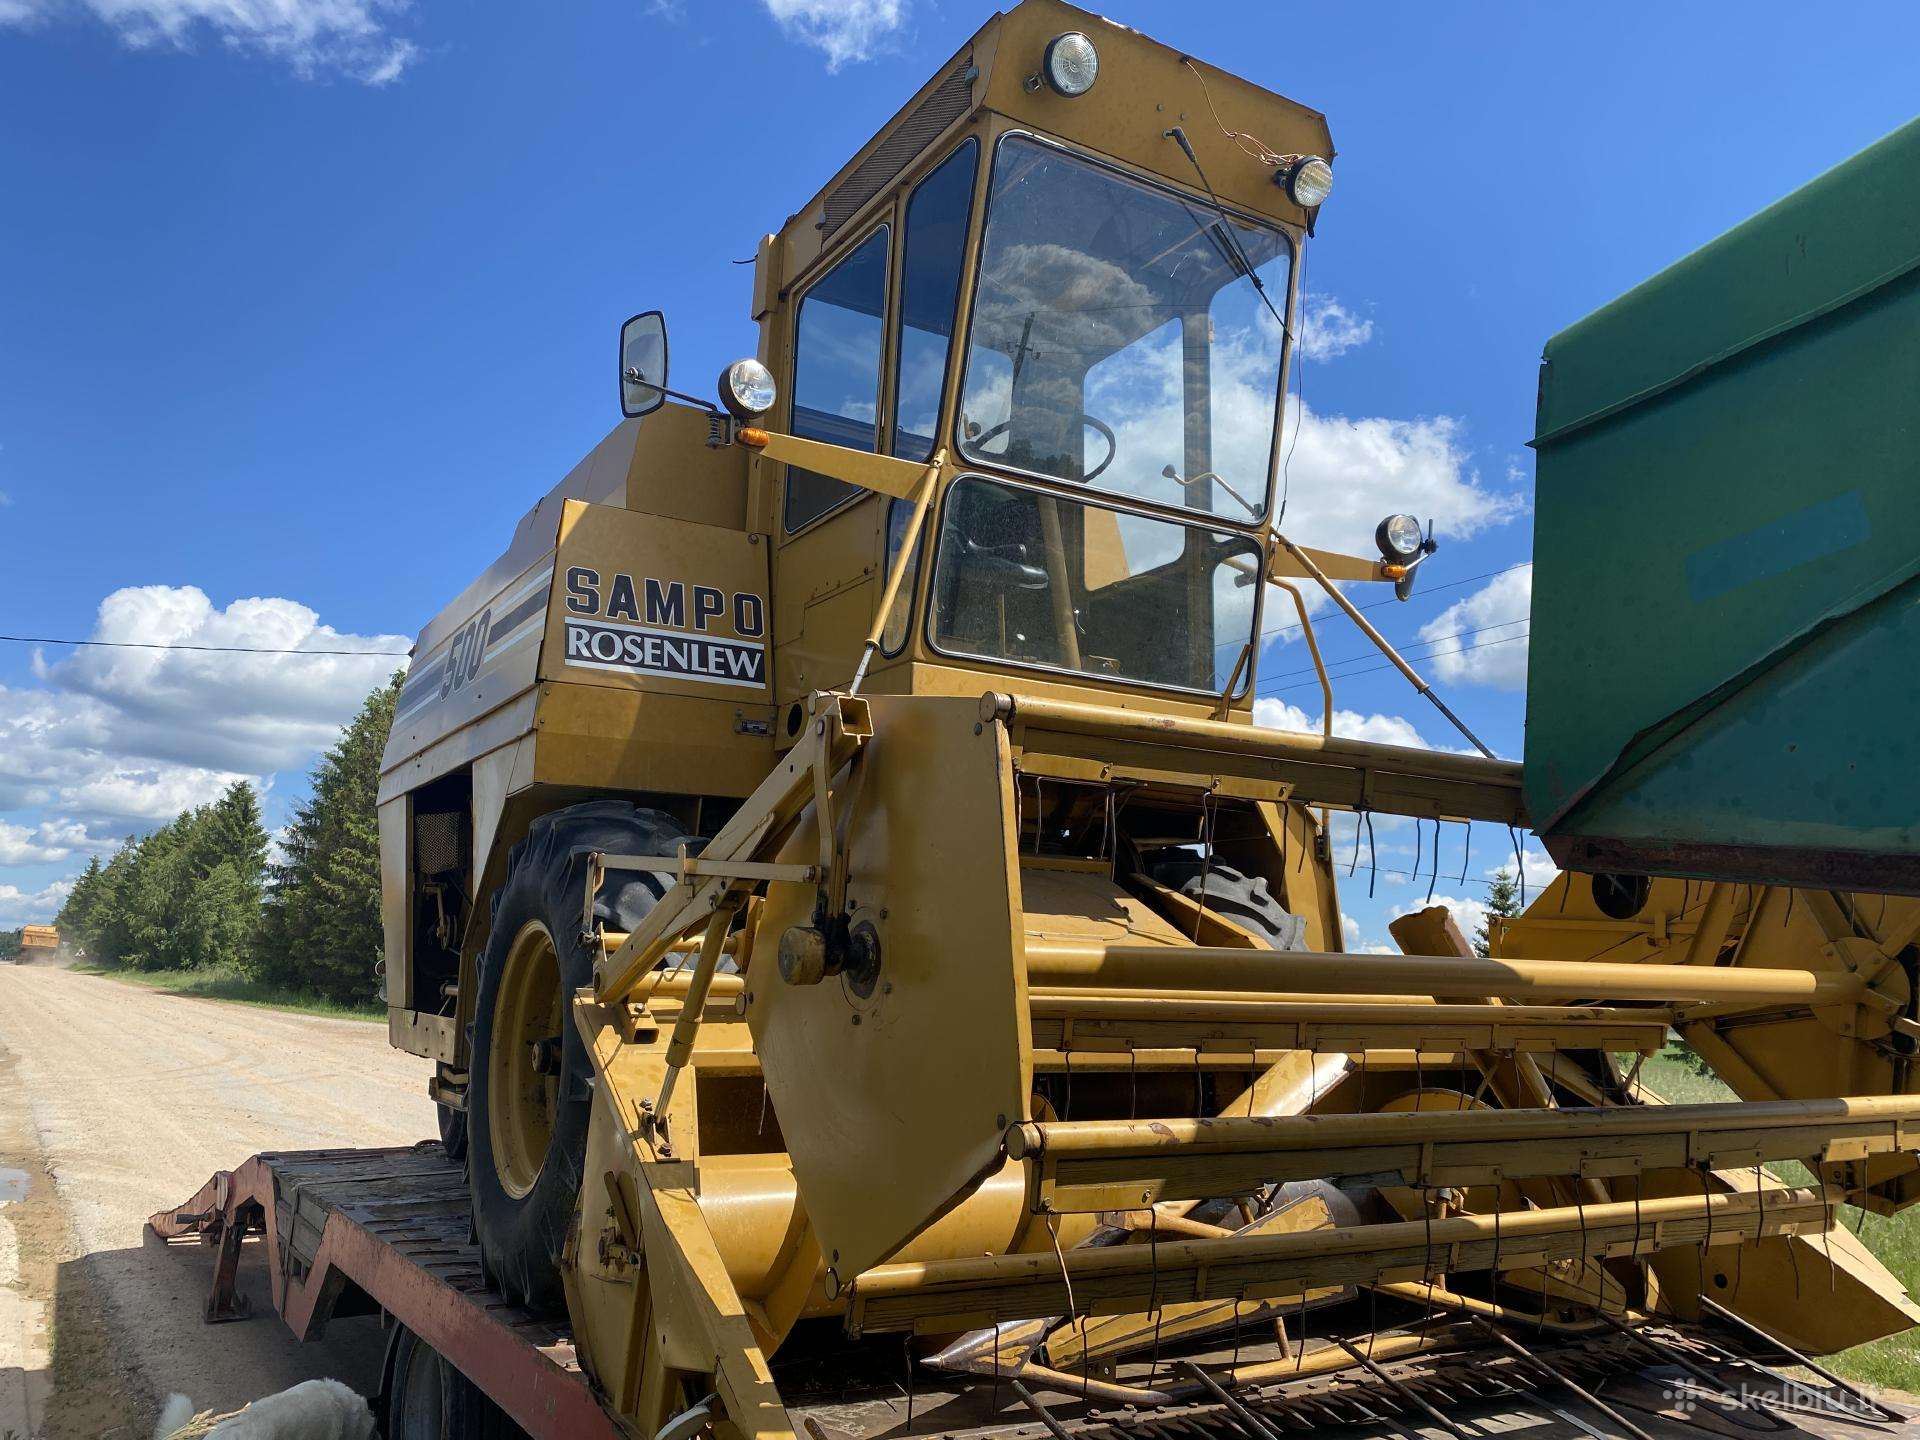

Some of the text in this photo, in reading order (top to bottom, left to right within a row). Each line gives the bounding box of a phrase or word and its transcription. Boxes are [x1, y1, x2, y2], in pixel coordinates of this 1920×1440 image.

[565, 565, 764, 638] SAMPO
[439, 608, 492, 703] 500
[567, 625, 762, 679] ROSENLEW
